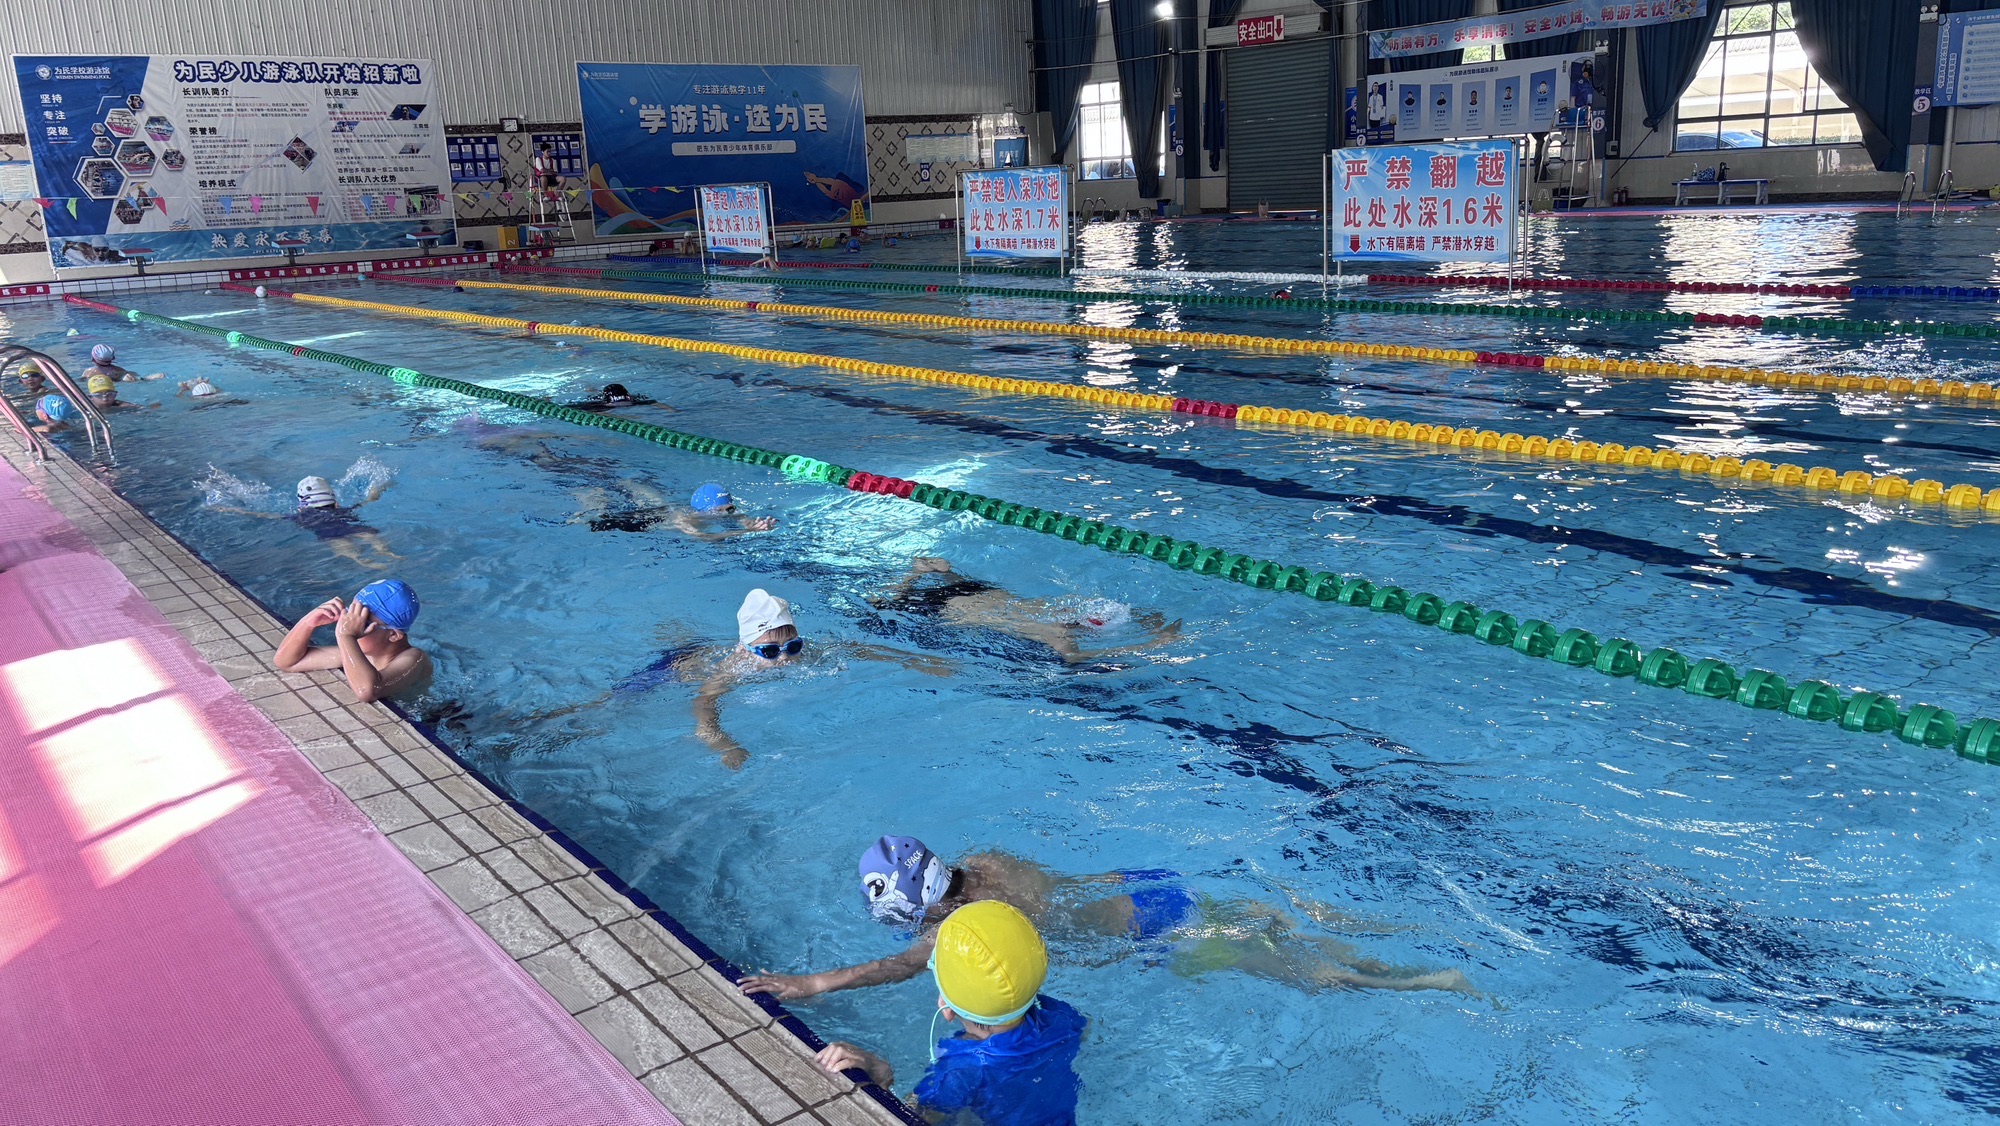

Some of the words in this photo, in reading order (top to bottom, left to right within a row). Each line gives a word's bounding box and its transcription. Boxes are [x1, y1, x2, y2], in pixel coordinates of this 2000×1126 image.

[1239, 20, 1274, 42] 安全出口
[174, 61, 421, 84] 为民少儿游泳队开始招新啦
[182, 87, 229, 96] 长训队简介
[324, 88, 359, 96] 队员风采
[693, 84, 766, 95] 专注游泳教学11年
[40, 94, 62, 104] 坚持
[1917, 98, 1926, 110] 5
[43, 110, 66, 120] 专注
[639, 103, 828, 134] 学游泳·选为民
[46, 126, 69, 136] 突破
[189, 127, 217, 135] 荣誉榜
[1343, 151, 1506, 191] 严禁翻越
[199, 180, 236, 188] 培养模式
[338, 175, 397, 183] 长训队八大优势
[969, 175, 1060, 203] 严禁越入深水池
[1343, 193, 1504, 229] 此处水深1.6米
[970, 206, 1060, 232] 此处水深1.7米
[1366, 236, 1426, 252] 水下有隔离墙
[904, 850, 923, 870] SPACE
